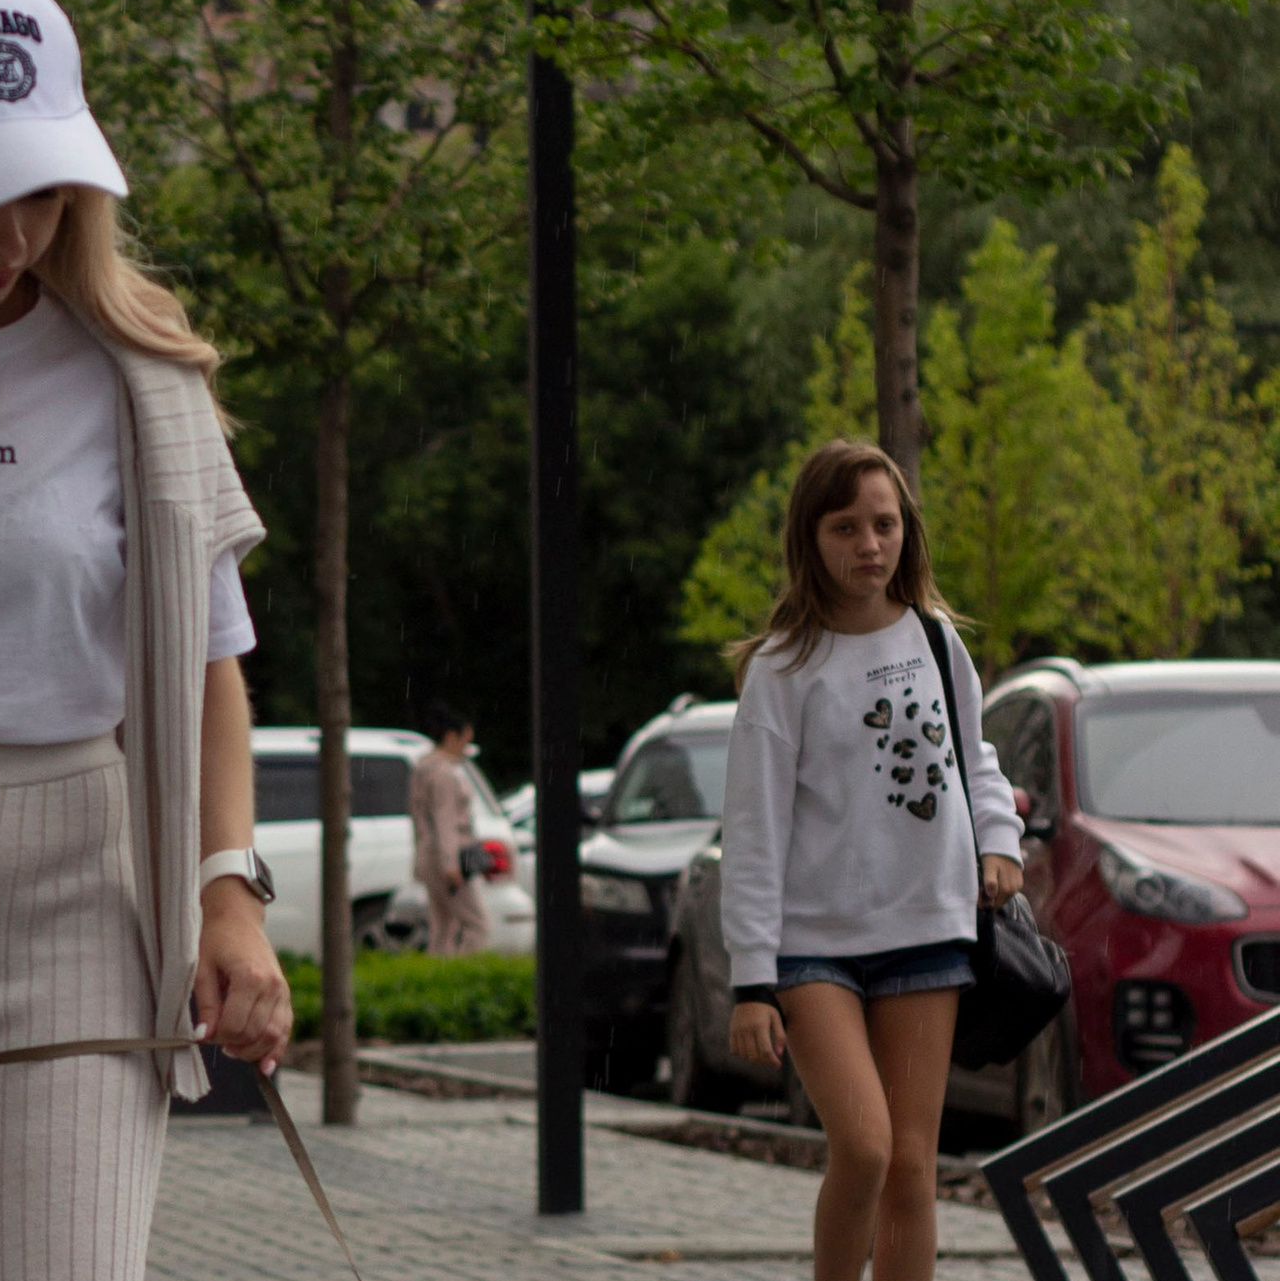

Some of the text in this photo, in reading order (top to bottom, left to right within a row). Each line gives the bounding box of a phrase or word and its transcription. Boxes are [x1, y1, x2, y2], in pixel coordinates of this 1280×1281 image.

[866, 657, 922, 678] ANIMALS ARE
[883, 671, 917, 686] lovely
